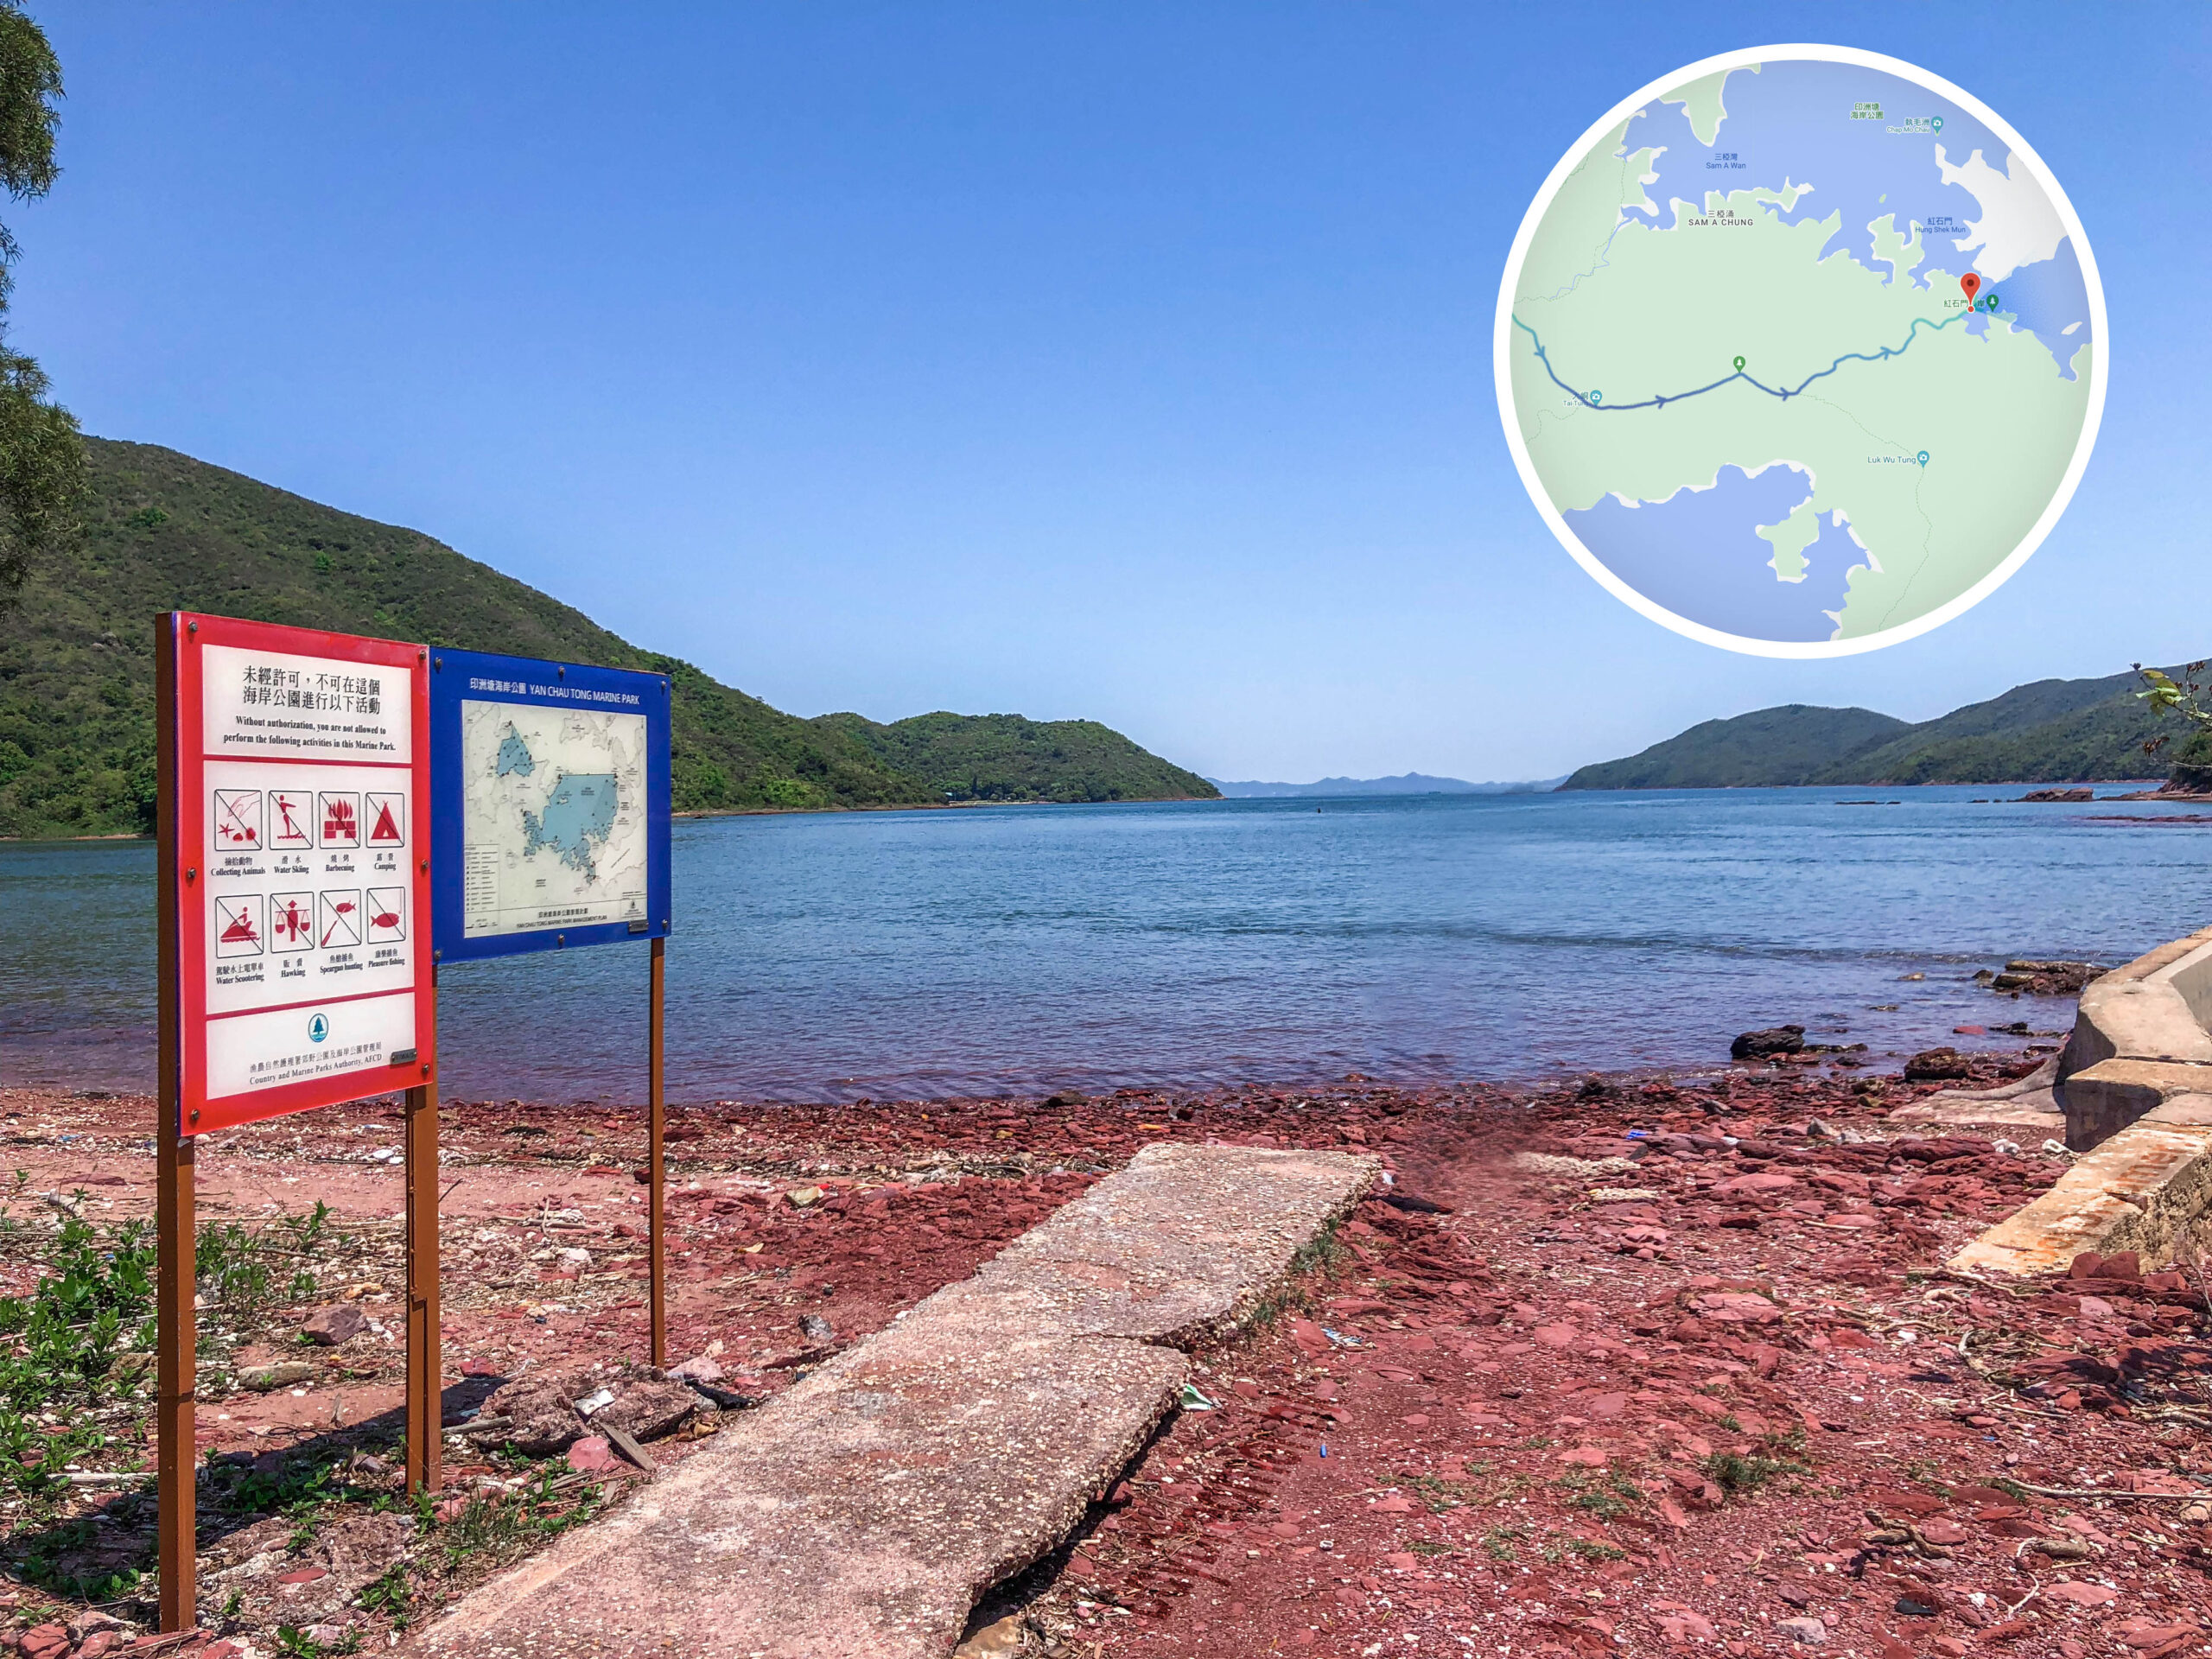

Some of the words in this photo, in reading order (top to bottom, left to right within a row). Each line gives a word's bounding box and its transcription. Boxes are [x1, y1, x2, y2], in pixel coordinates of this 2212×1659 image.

[469, 677, 526, 694] 印洲塘海岸公園
[530, 683, 547, 696] YAN
[548, 686, 569, 698] CHAU
[570, 689, 592, 701] TONG
[593, 691, 620, 702] MARINE
[622, 694, 639, 705] PARK
[243, 685, 380, 715] 海岸公園進行以下活動
[236, 715, 265, 727] Without
[267, 719, 315, 731] authorization,
[317, 723, 328, 733] you
[355, 725, 378, 734] allowed
[224, 733, 253, 743] perform
[256, 734, 267, 743] the
[269, 735, 301, 747] following
[302, 737, 332, 747] activities
[334, 739, 340, 747] in
[342, 739, 353, 748] this
[355, 741, 378, 750] Marine
[379, 741, 396, 750] Park.
[211, 868, 241, 877] Collecting
[242, 867, 266, 875] Animals
[234, 974, 264, 982] Scootering
[281, 969, 306, 977] Hawking
[250, 1075, 276, 1085] Country
[278, 1071, 290, 1079] and
[292, 1067, 314, 1078] Marine
[315, 1063, 332, 1072] Parks
[365, 1054, 382, 1064] AFCD
